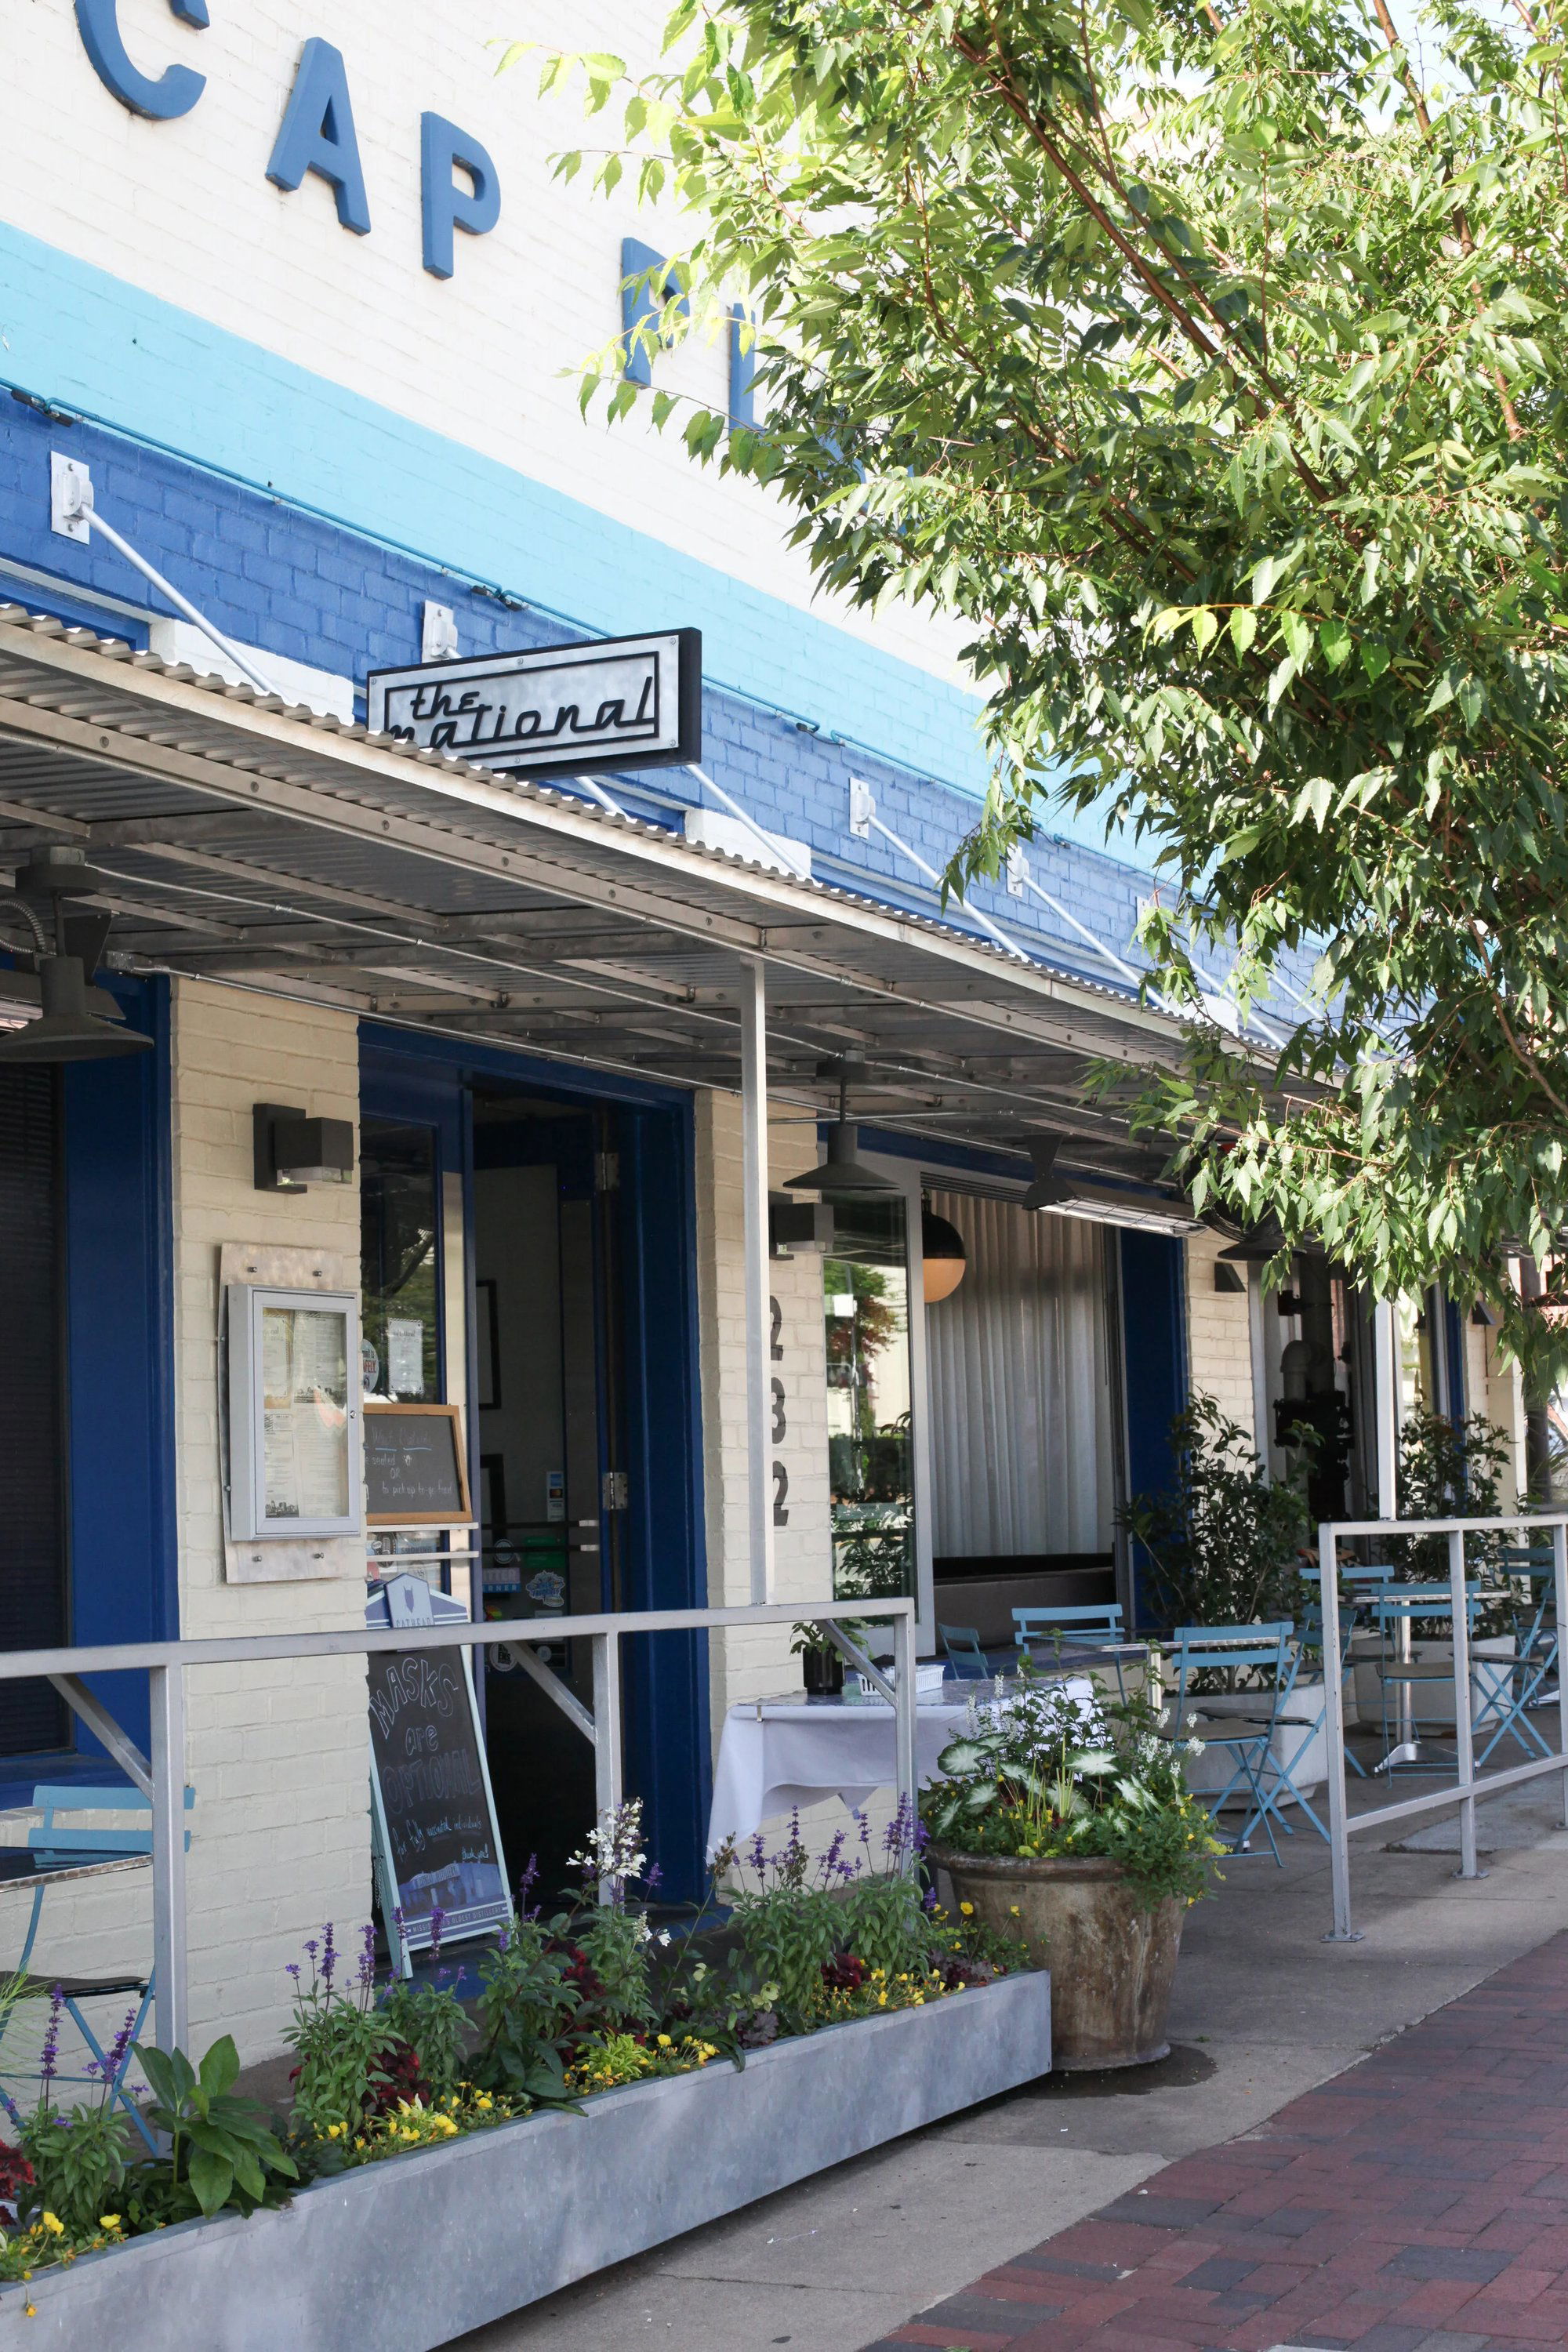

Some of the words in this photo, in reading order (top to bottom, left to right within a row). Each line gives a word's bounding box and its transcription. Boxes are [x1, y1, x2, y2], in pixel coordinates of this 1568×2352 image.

[410, 682, 480, 720] the
[395, 1617, 433, 1628] CATHEAD
[369, 1657, 459, 1740] MASKS
[405, 1725, 439, 1756] are
[381, 1748, 482, 1815] OPTIONAL
[452, 1913, 471, 1925] OLDEST
[473, 1907, 502, 1920] DISTILLERY
